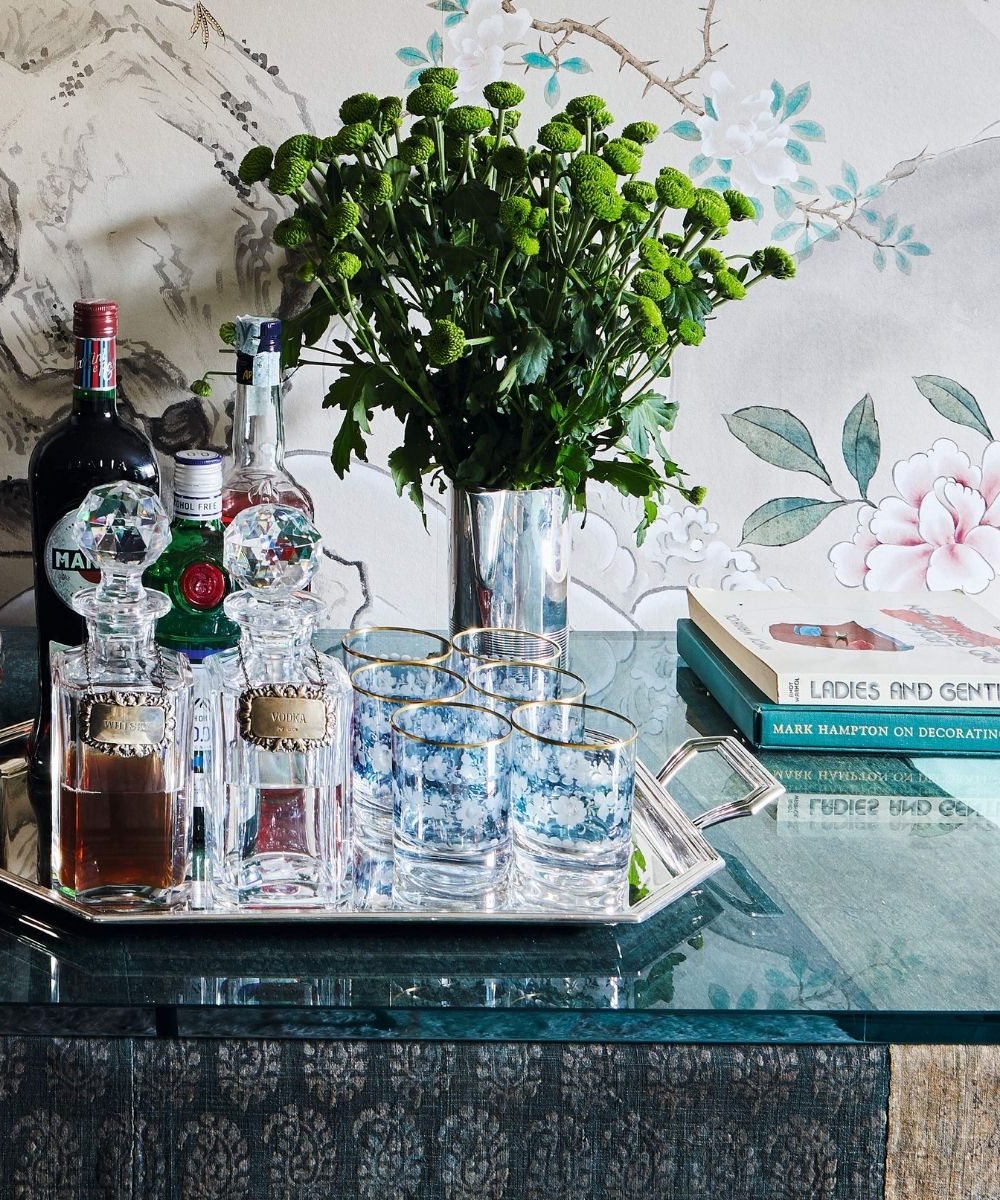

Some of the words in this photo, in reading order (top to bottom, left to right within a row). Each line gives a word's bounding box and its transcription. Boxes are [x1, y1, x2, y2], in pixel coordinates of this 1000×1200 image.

[198, 502, 217, 510] FREE
[810, 680, 881, 701] LADIES
[890, 681, 933, 701] AND
[271, 711, 308, 724] VODKA
[773, 724, 813, 735] MARK
[818, 724, 889, 737] HAMPTON
[893, 726, 915, 737] ON
